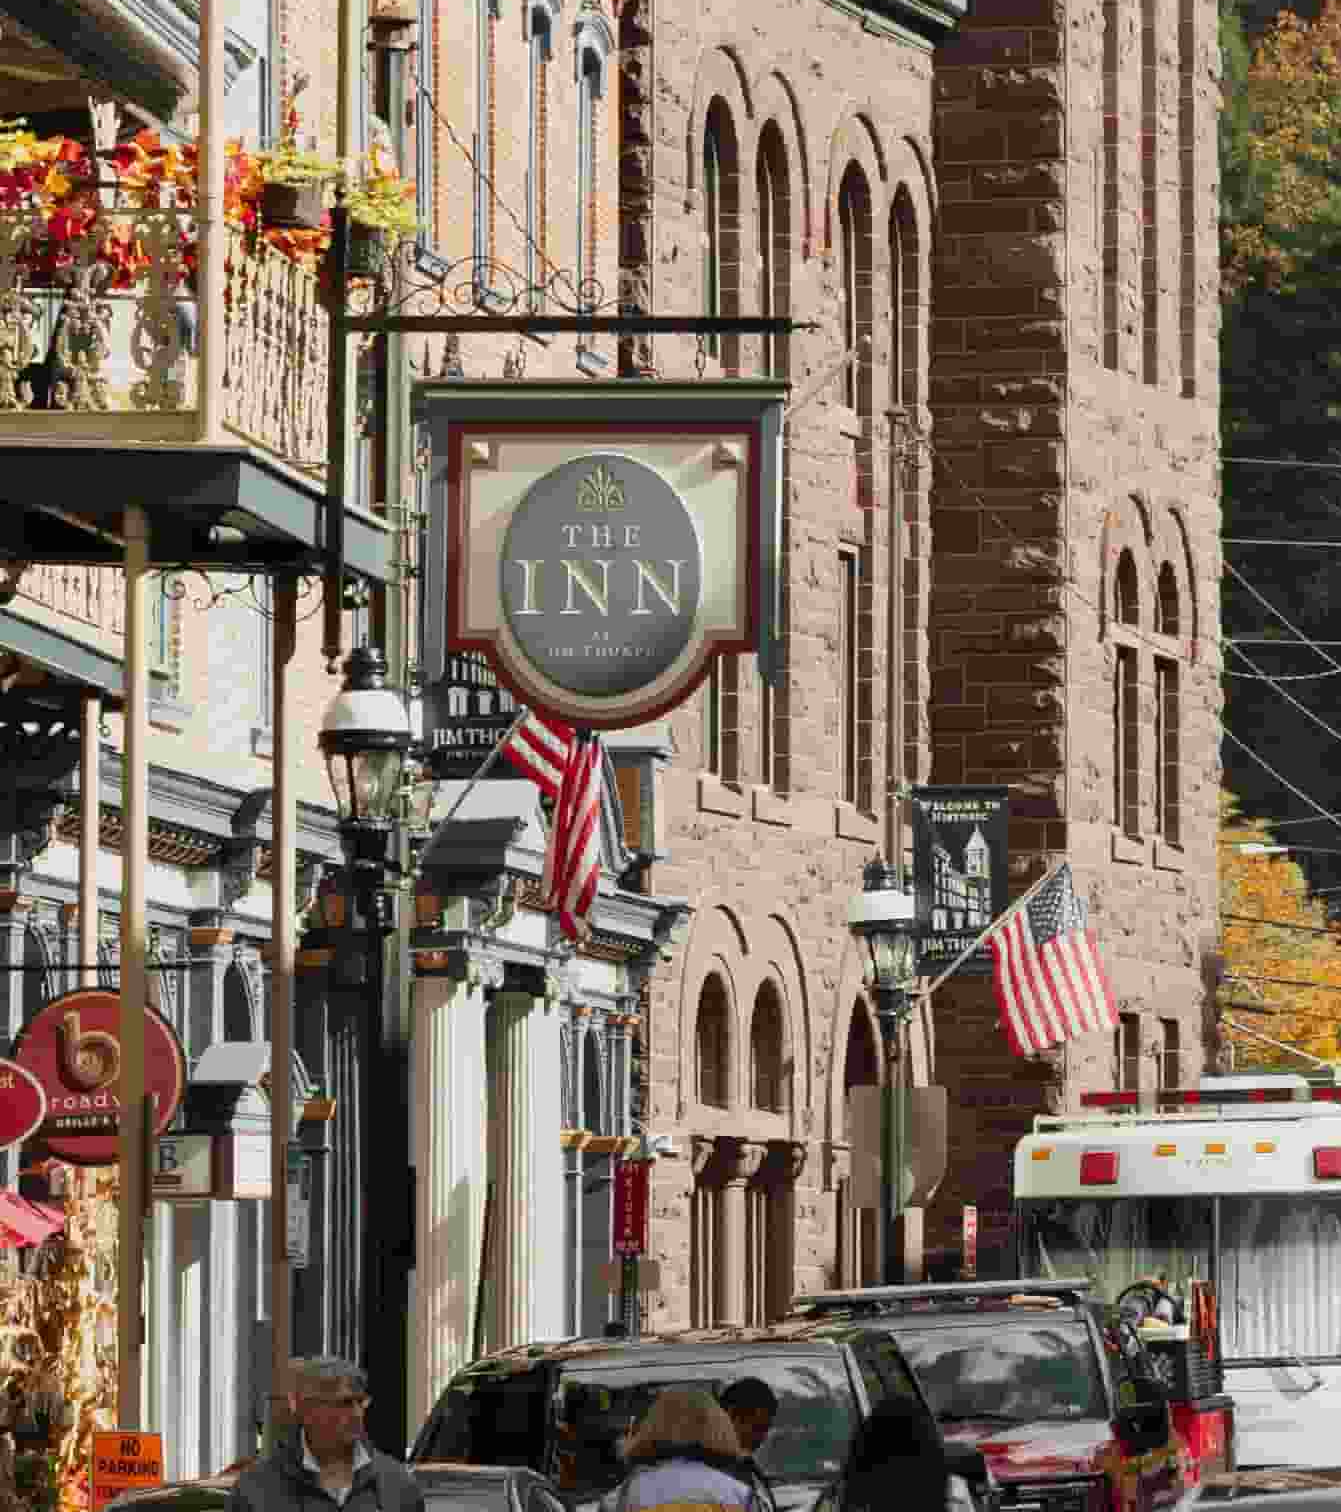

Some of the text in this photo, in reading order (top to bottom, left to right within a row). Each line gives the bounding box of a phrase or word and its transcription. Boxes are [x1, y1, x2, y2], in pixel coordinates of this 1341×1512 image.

[561, 525, 641, 548] THE
[512, 559, 688, 616] INN
[432, 728, 464, 752] JIM
[119, 1439, 142, 1457] NO
[97, 1459, 160, 1477] PARKING
